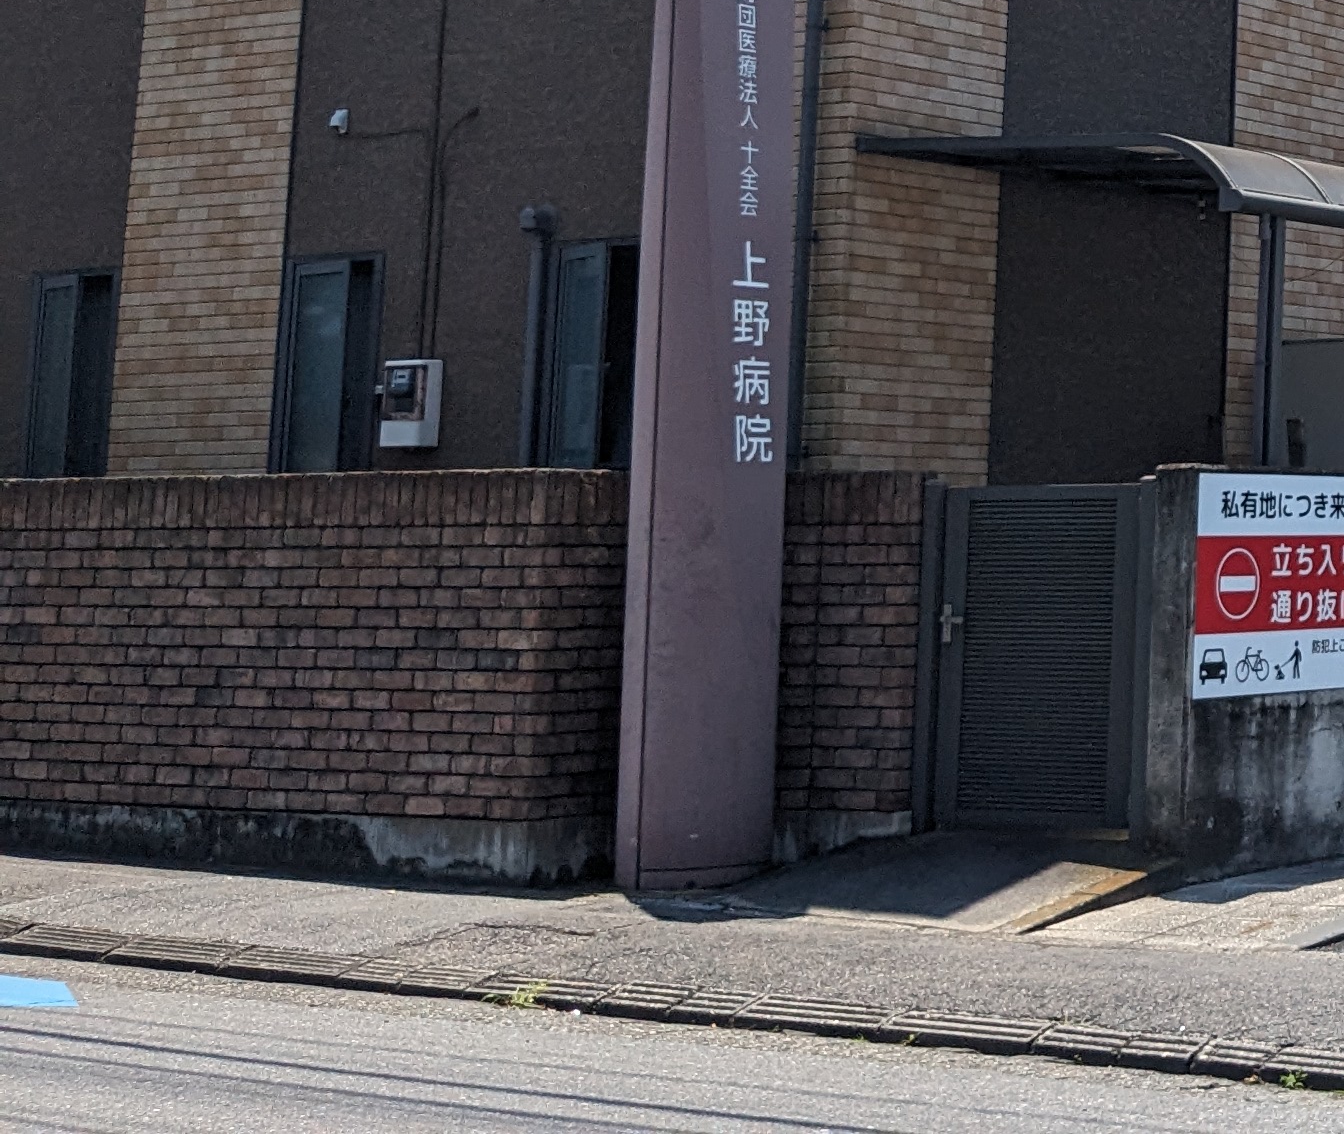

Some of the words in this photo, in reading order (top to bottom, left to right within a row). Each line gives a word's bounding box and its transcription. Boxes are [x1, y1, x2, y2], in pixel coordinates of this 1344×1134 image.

[739, 140, 759, 216] 十全会
[732, 240, 773, 463] 上野病院
